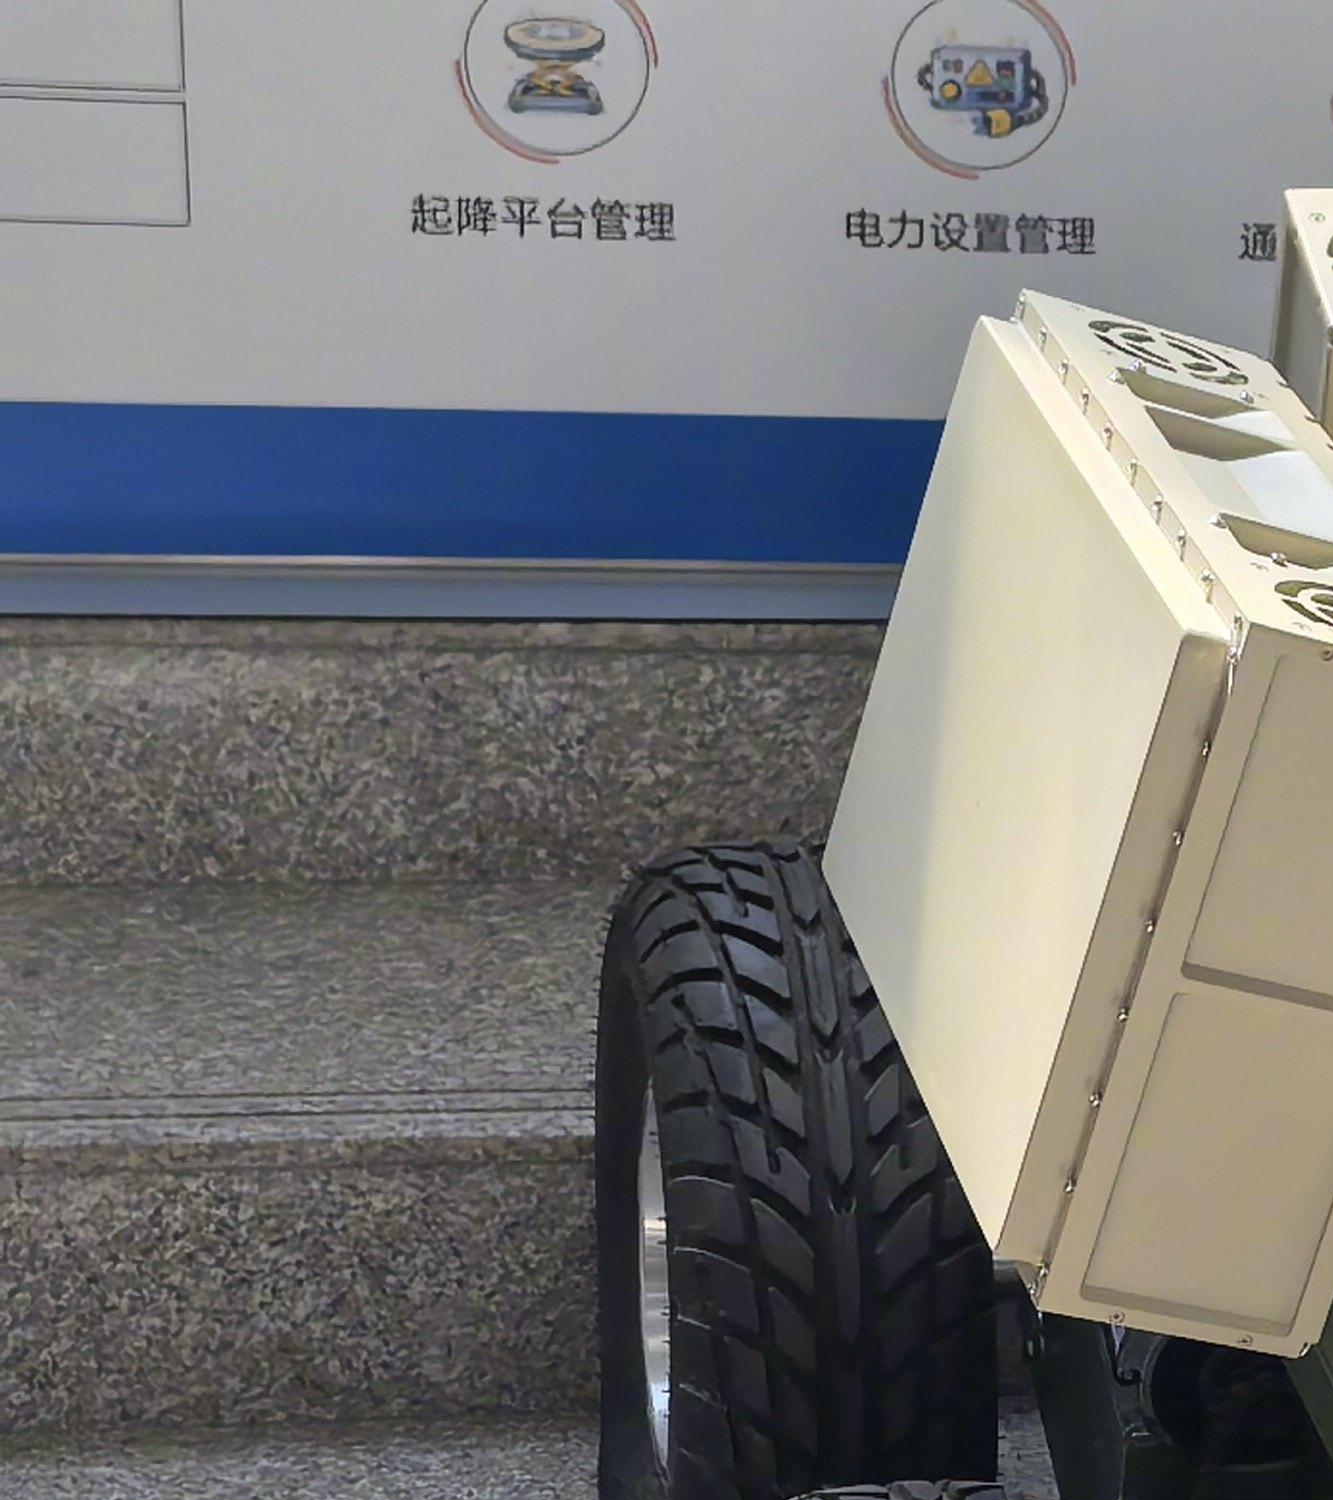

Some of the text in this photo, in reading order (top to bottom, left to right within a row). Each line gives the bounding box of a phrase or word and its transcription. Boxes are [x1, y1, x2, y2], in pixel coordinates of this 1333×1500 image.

[410, 195, 676, 243] 起降平台管理
[846, 210, 1096, 256] 电力设置管理
[1239, 222, 1277, 261] 通
